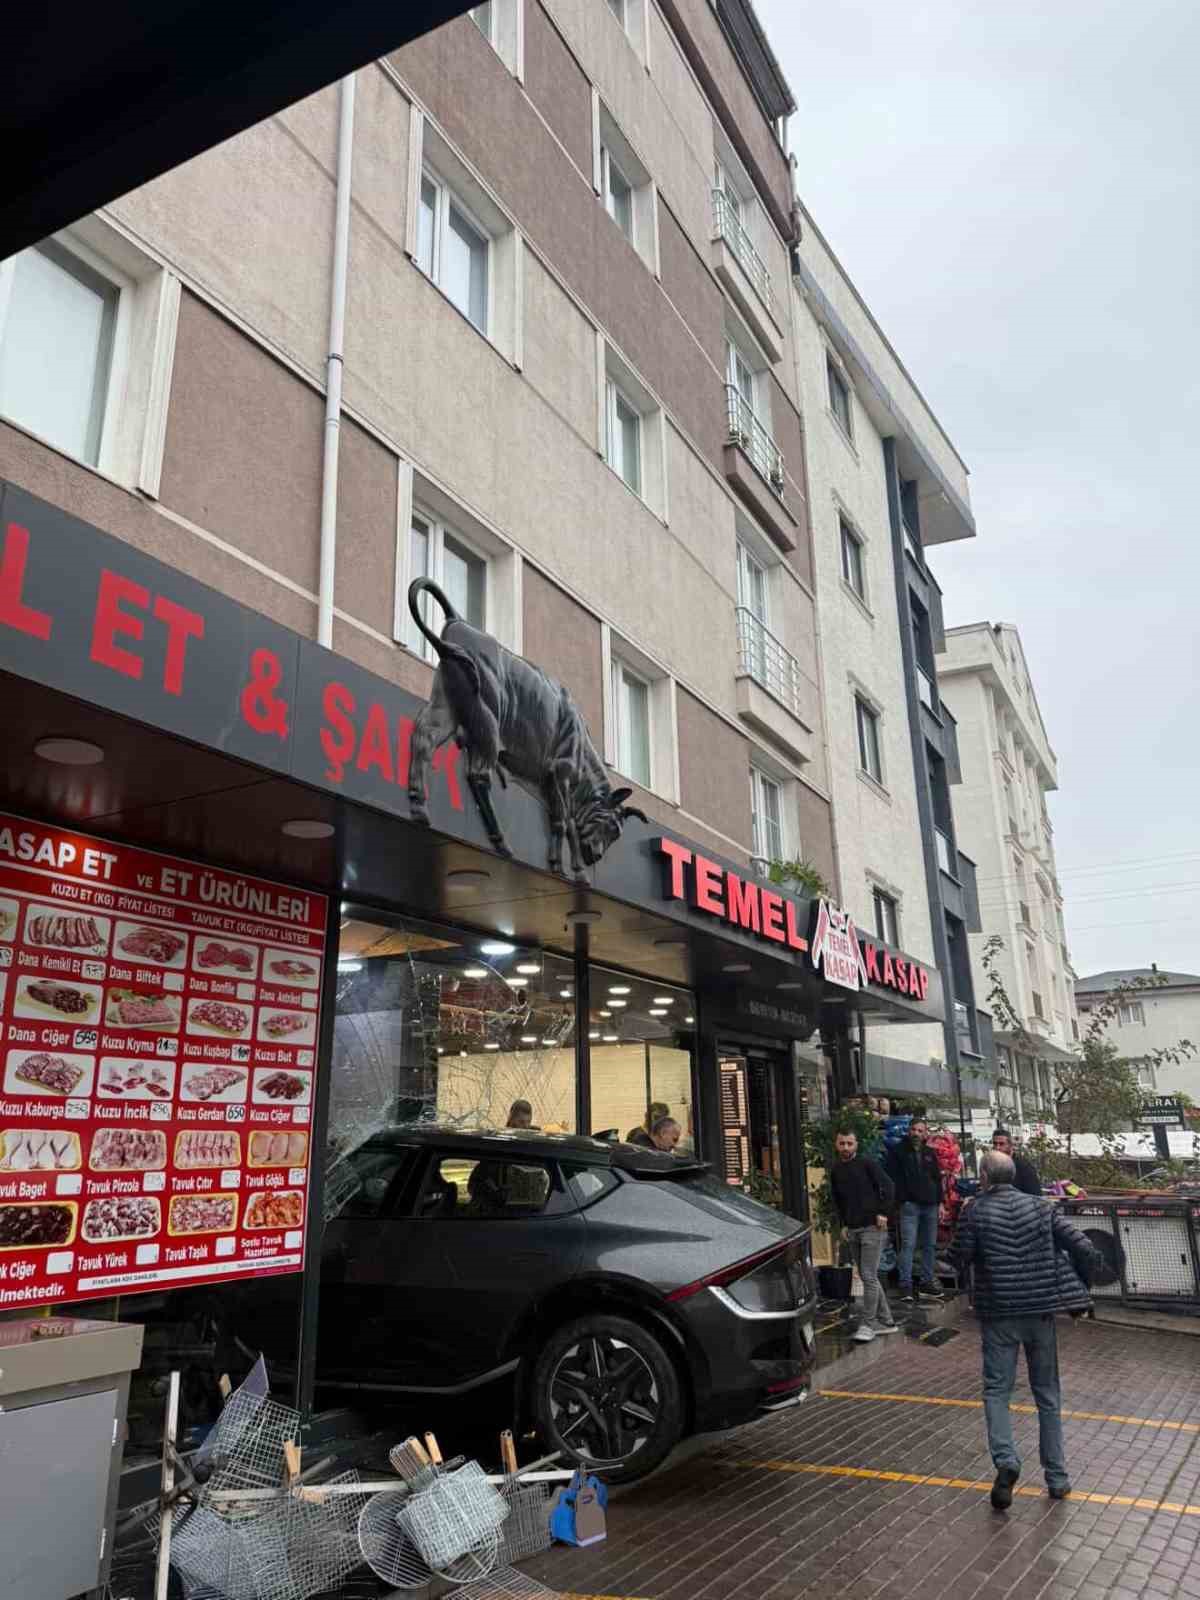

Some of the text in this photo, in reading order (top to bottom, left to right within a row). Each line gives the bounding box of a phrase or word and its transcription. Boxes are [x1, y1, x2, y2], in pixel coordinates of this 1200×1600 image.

[90, 568, 205, 697] ET
[241, 648, 289, 740] &
[83, 848, 118, 879] ET
[137, 874, 153, 888] VE
[160, 868, 192, 896] ET
[200, 872, 310, 922] ÜRÜNLERİ
[661, 836, 808, 951] TEMEL
[51, 882, 78, 898] KUZU
[80, 889, 92, 900] ET
[94, 891, 115, 907] (KG)
[118, 896, 142, 911] FİYAT
[192, 912, 223, 928] TAVUK
[223, 918, 236, 930] ET
[18, 951, 39, 967] Dana
[109, 966, 132, 980] Dana
[136, 969, 161, 985] Biftek
[865, 943, 928, 1000] KASAP
[8, 1026, 70, 1046] Dana Ciğer
[101, 1034, 155, 1053] Kuzu Kıyma
[183, 1042, 202, 1056] Kuzu
[255, 1048, 276, 1062] Kuzu
[277, 1050, 292, 1063] But
[0, 1101, 64, 1120] Kuzu Kaburga
[93, 1103, 150, 1119] Kuzu İncik
[177, 1107, 225, 1120] Kuzu Gerdan
[227, 1106, 245, 1120] 650
[250, 1109, 269, 1121] Kuzu
[19, 1181, 47, 1199] Baget
[86, 1179, 111, 1194] Tavuk
[112, 1178, 139, 1193] Pirzola
[172, 1177, 194, 1190] Tavuk
[246, 1175, 264, 1187] Tavuk
[77, 1252, 128, 1271] Tavuk Yürek
[165, 1247, 187, 1262] Tavuk
[9, 1260, 37, 1280] Ciğer
